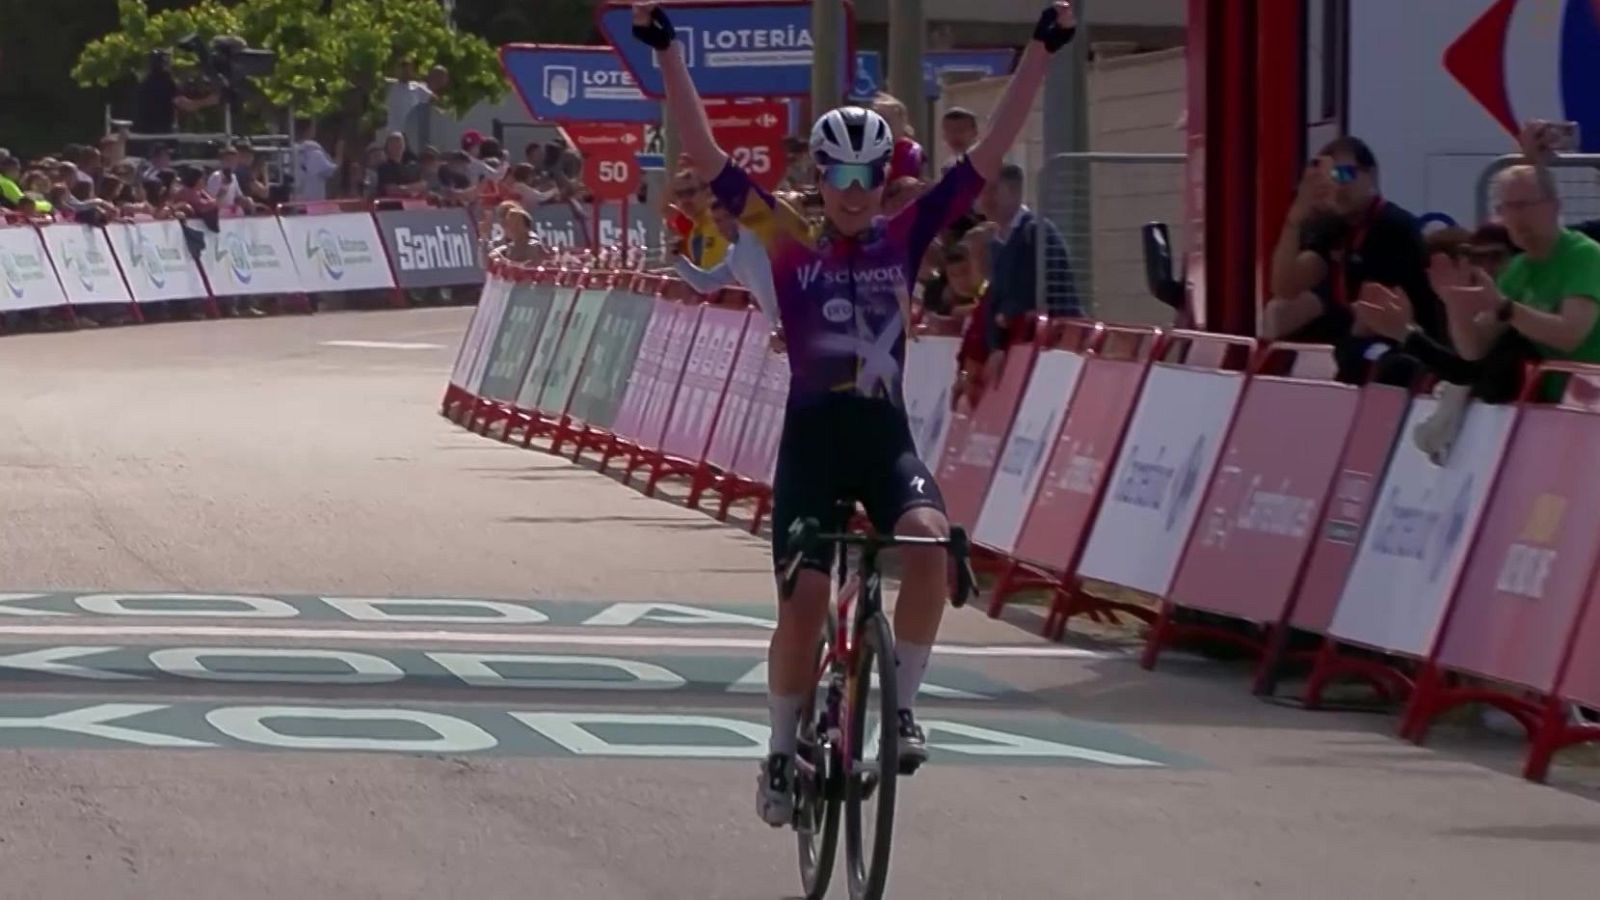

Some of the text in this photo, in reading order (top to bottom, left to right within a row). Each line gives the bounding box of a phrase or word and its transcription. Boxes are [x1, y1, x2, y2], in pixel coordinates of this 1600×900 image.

[702, 25, 815, 49] LOTERÍA
[599, 161, 628, 183] 50
[733, 147, 771, 174] 25
[396, 224, 473, 270] Santini
